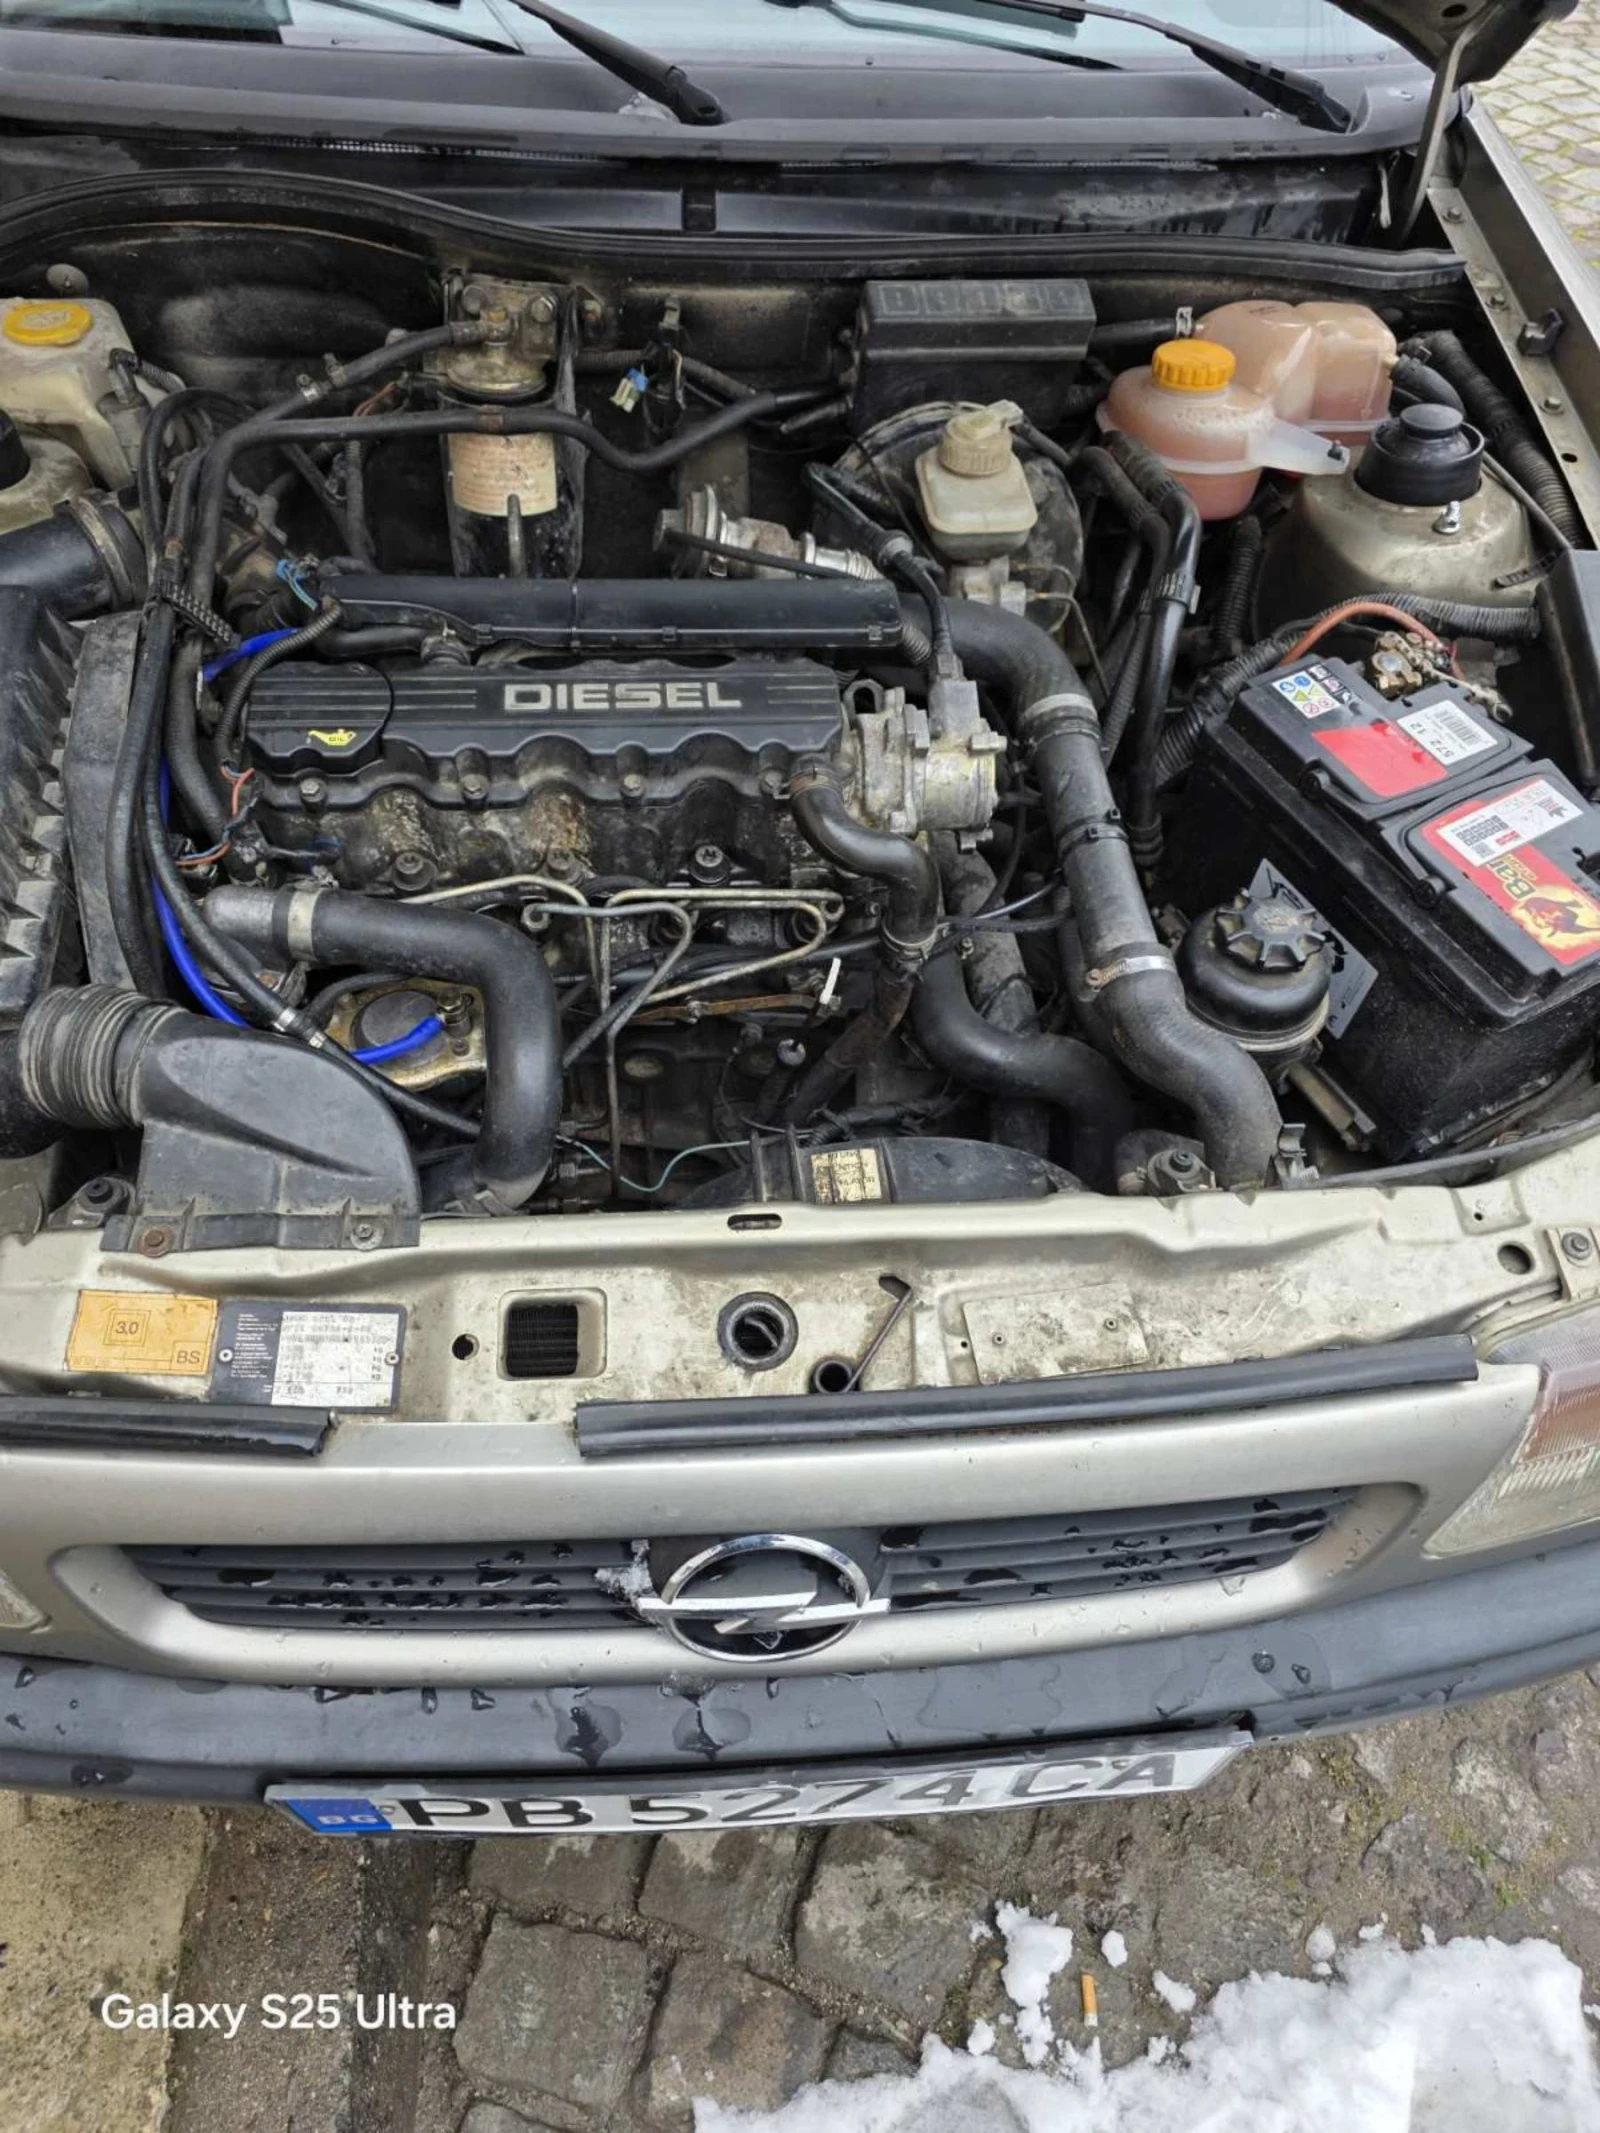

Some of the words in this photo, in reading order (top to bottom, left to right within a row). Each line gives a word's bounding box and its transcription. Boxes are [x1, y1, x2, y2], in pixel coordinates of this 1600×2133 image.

[504, 682, 743, 711] DIESEL
[176, 1351, 200, 1364] BS
[400, 1798, 593, 1828] PB
[629, 1770, 977, 1824] 5274
[1011, 1754, 1176, 1798] CA
[317, 1814, 379, 1825] BG
